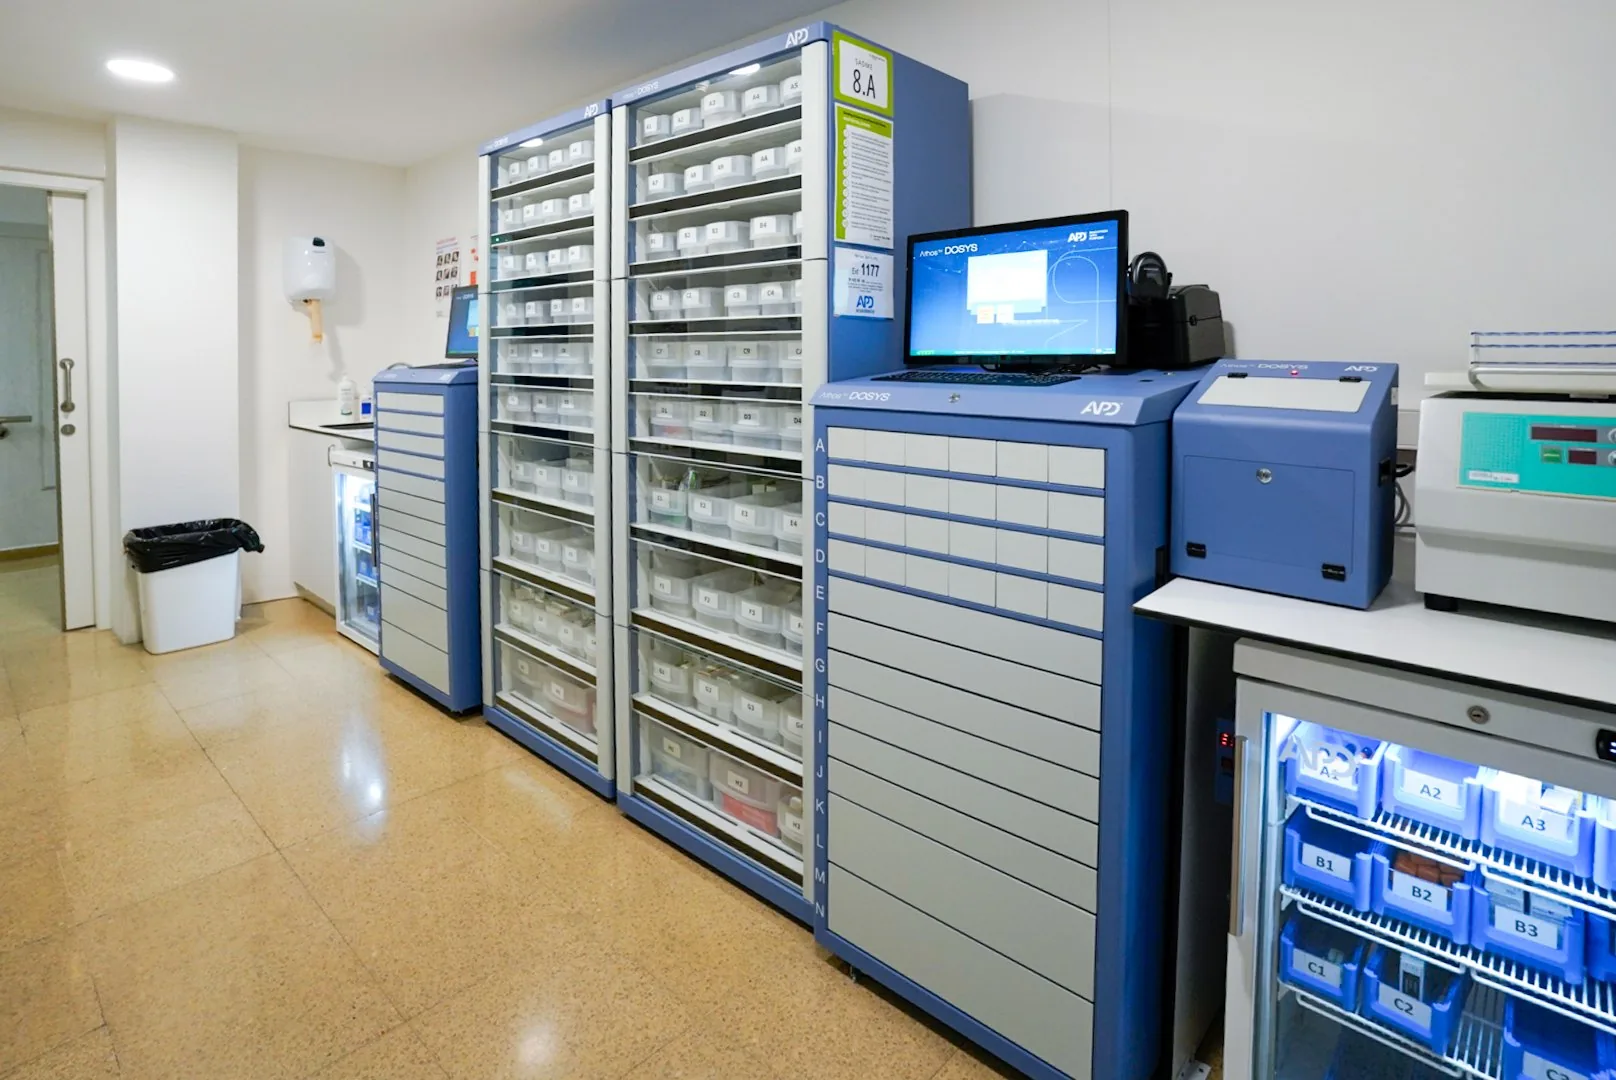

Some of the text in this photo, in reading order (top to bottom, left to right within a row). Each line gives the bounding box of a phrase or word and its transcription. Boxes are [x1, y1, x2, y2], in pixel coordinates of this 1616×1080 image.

[785, 27, 809, 48] APD
[853, 69, 876, 99] 8.A
[584, 103, 599, 118] APD
[1067, 231, 1088, 243] APD
[944, 243, 978, 255] DOSYS
[861, 263, 880, 277] 1177
[856, 295, 874, 309] APD
[848, 391, 891, 401] DOSYS
[1080, 400, 1121, 416] APD
[815, 438, 825, 452] A
[815, 475, 825, 489] B
[815, 512, 825, 526] C
[815, 549, 825, 563] D
[816, 585, 824, 600] E
[816, 622, 824, 635] F
[815, 658, 825, 672] G
[816, 693, 825, 709] H
[816, 765, 823, 778] J
[1420, 784, 1442, 800] A2
[815, 798, 824, 814] K
[1521, 815, 1546, 831] A3
[816, 833, 824, 848] L
[1316, 856, 1334, 872] B1
[815, 867, 825, 884] M
[1412, 886, 1432, 902] B2
[815, 902, 824, 918] N
[1515, 920, 1538, 937] B3
[1308, 961, 1326, 977] C1
[1394, 998, 1414, 1016] C2
